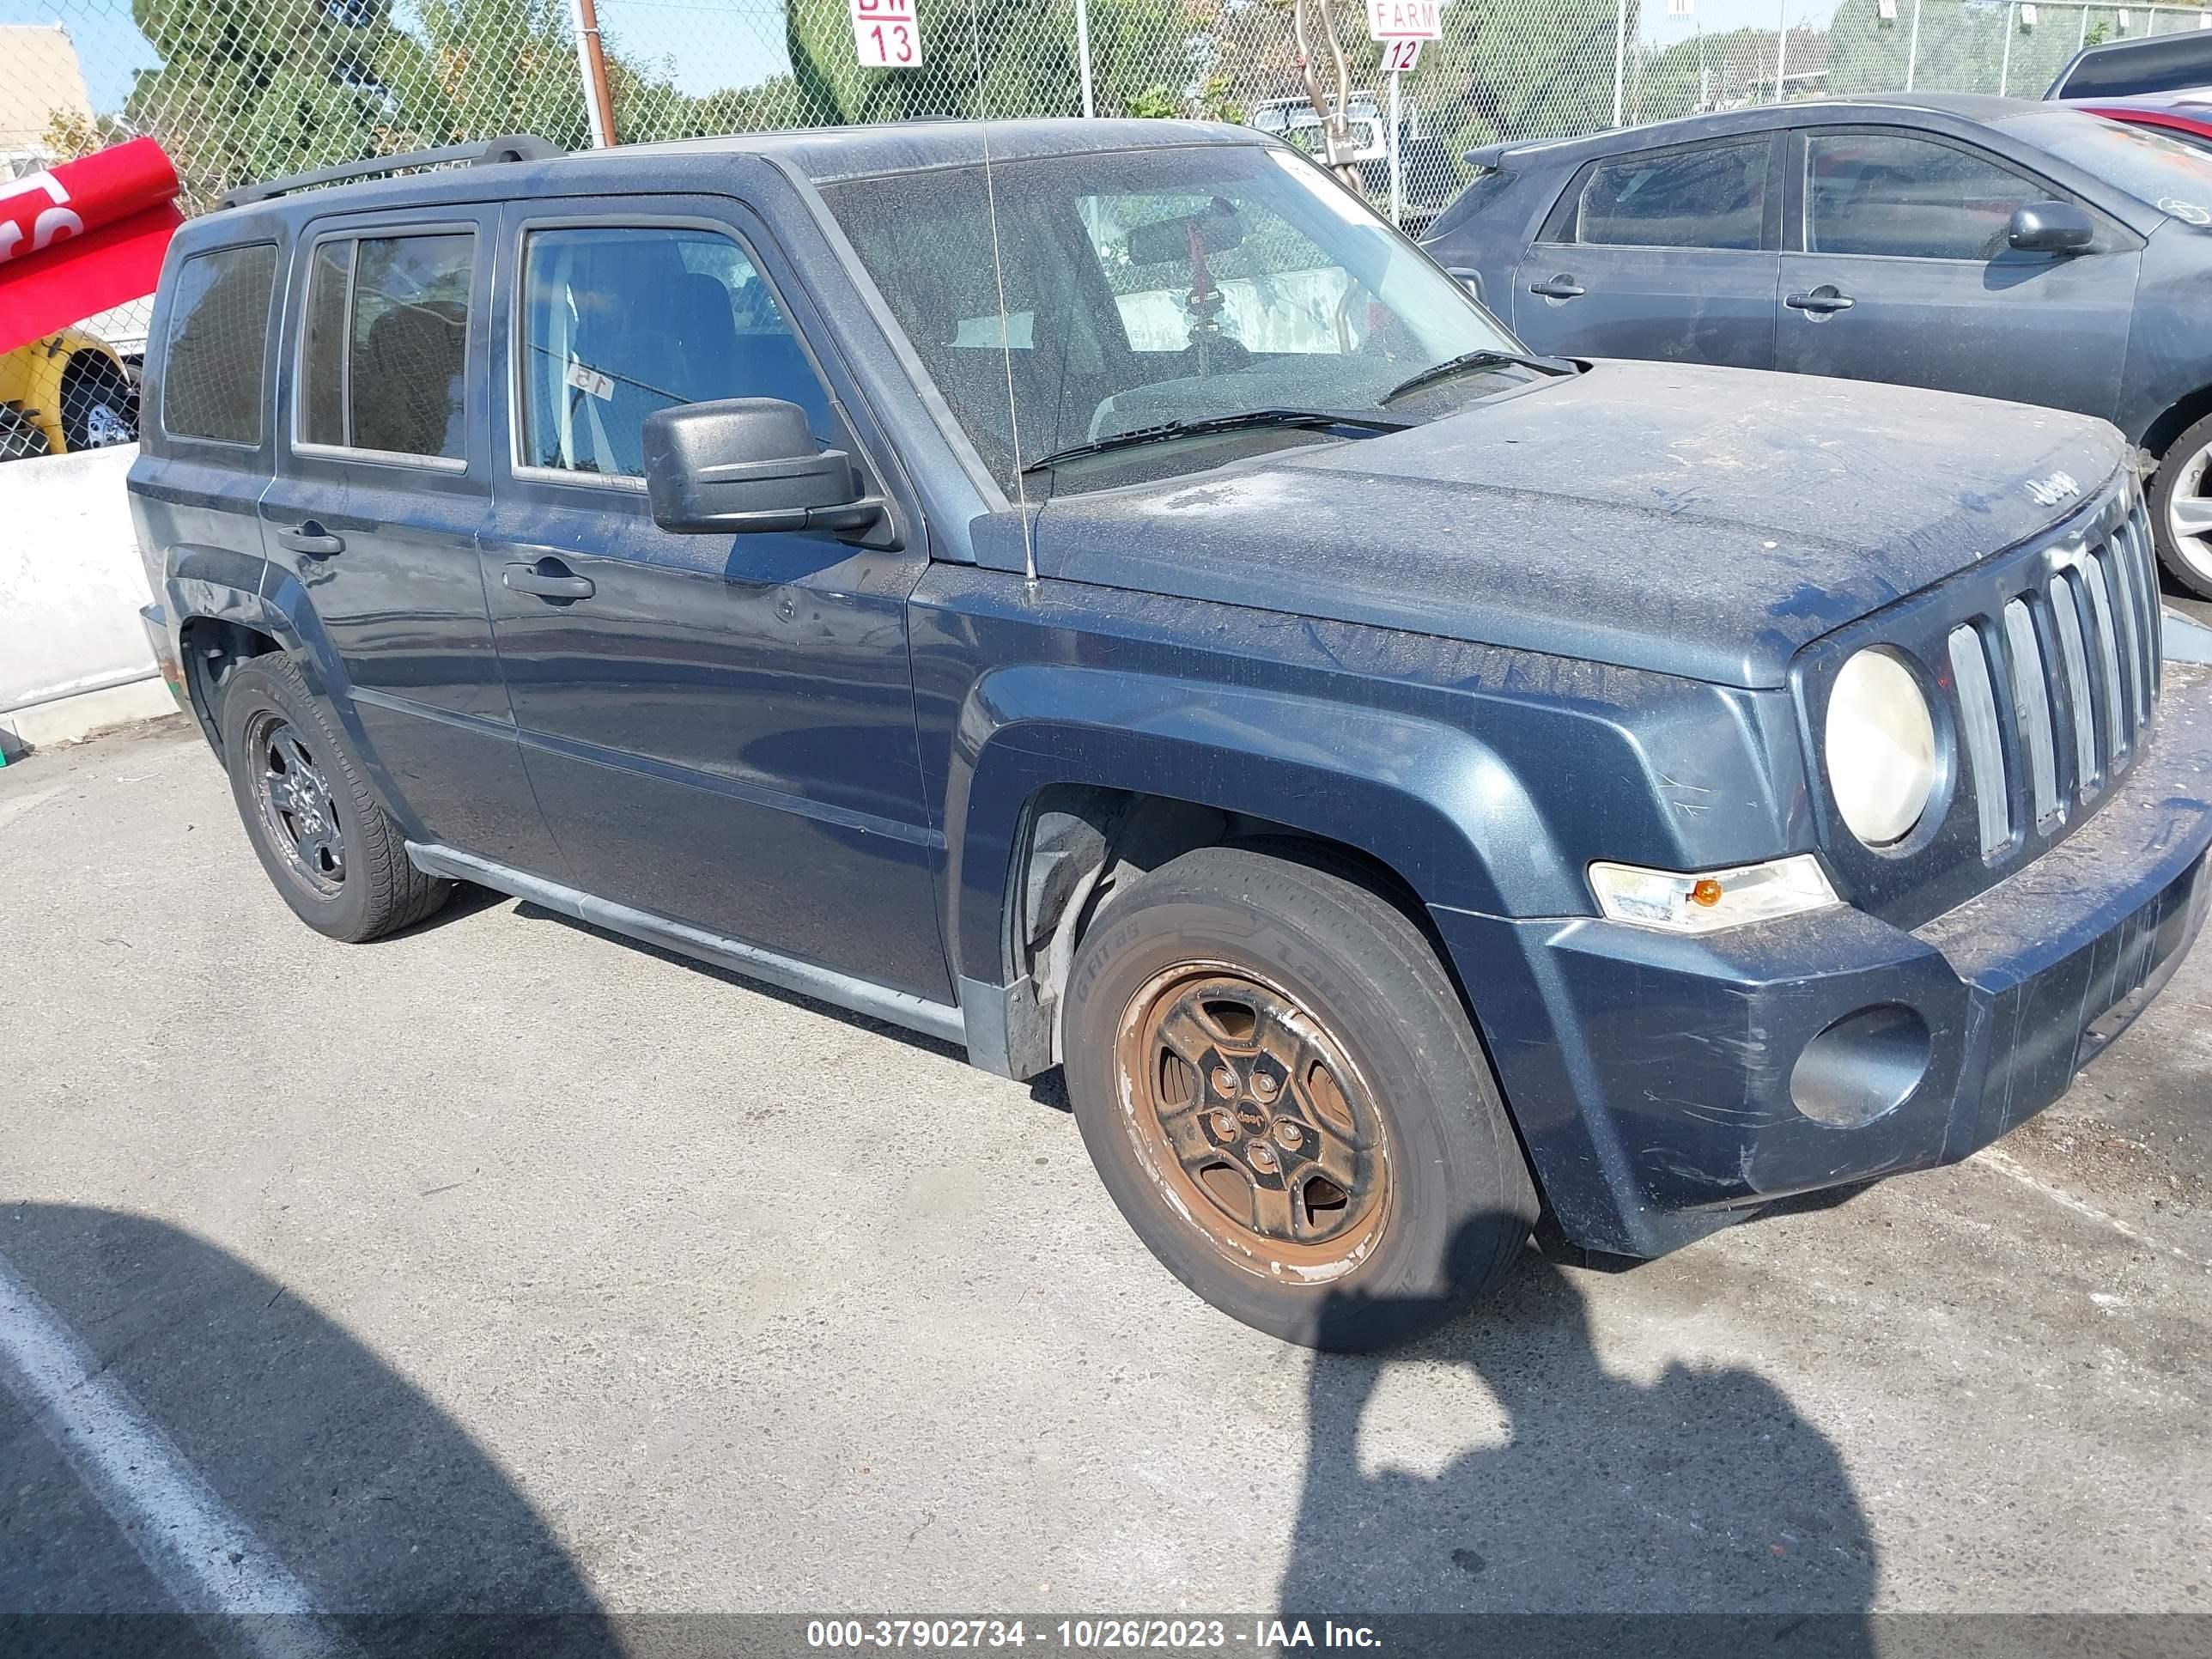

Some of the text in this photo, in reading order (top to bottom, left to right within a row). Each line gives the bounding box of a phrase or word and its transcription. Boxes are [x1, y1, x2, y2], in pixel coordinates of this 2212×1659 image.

[1376, 3, 1436, 27] FARM
[871, 24, 912, 63] 13
[1391, 40, 1417, 69] 12
[1237, 1109, 1265, 1127] Jeep
